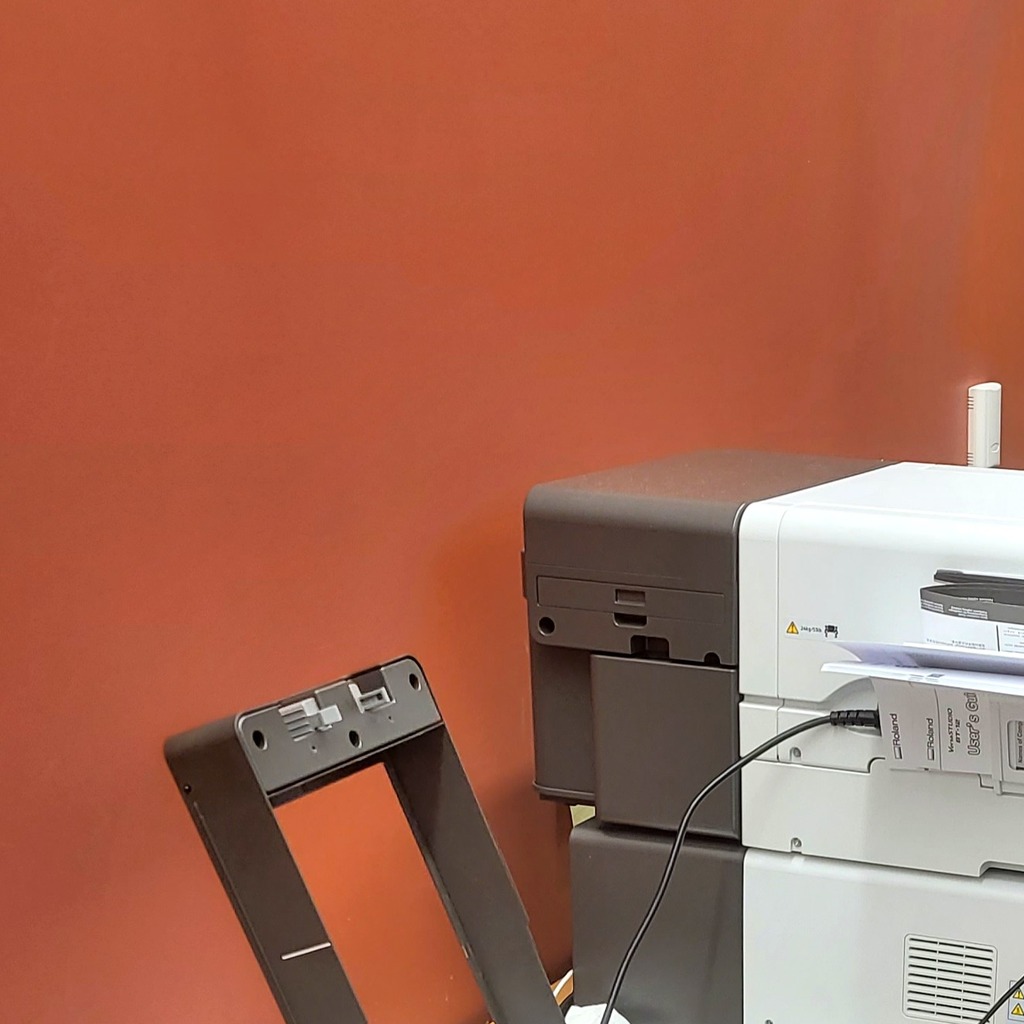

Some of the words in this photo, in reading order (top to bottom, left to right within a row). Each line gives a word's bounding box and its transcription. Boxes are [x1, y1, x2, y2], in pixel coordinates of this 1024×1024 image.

[889, 713, 901, 747] Roland
[926, 718, 935, 749] Roland
[965, 714, 980, 755] User's
